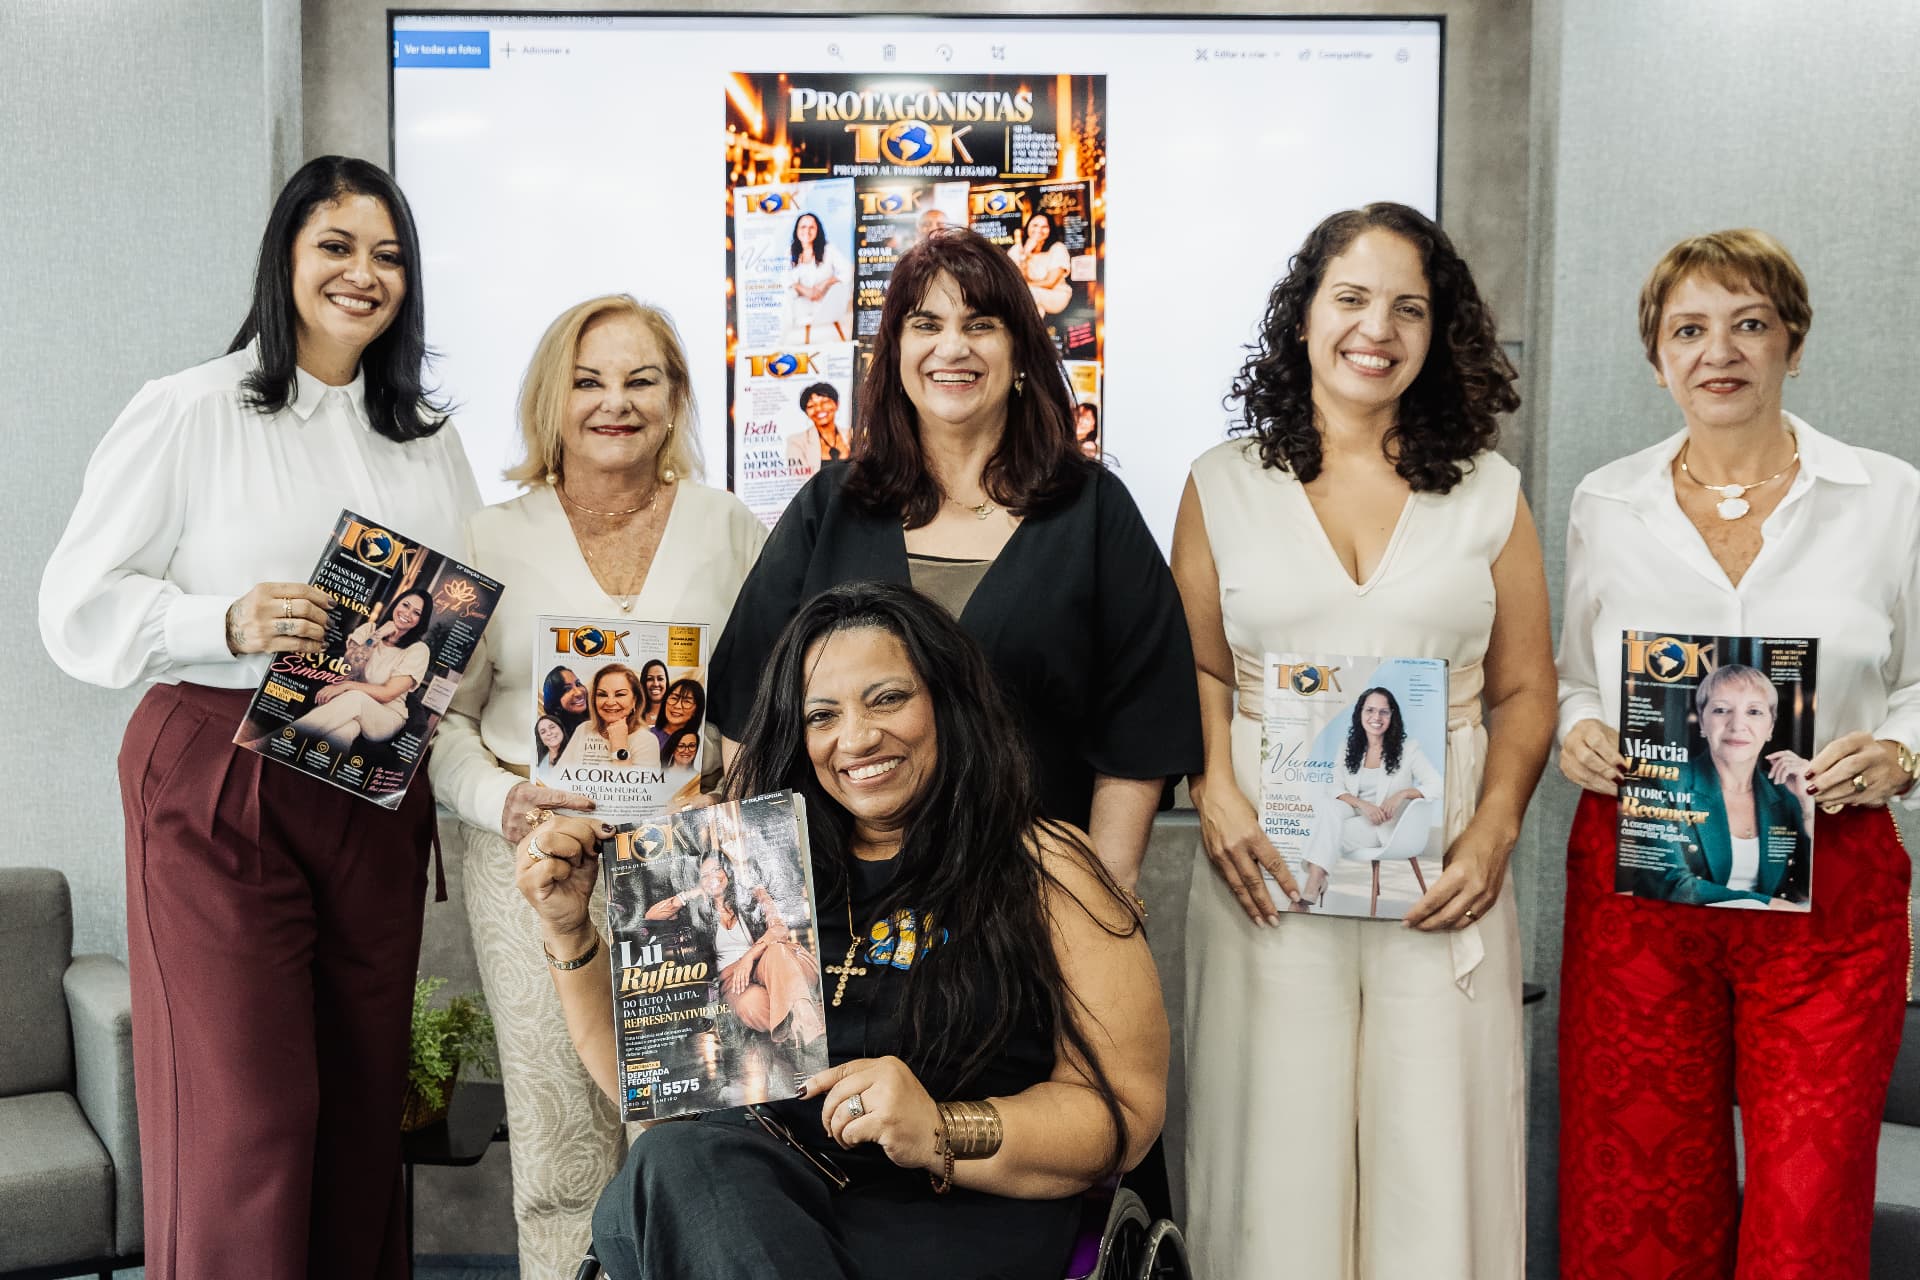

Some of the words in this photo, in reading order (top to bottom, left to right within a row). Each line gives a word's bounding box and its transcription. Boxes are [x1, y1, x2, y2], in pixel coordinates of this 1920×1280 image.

[404, 44, 420, 55] Ver
[422, 44, 446, 55] todas
[459, 44, 482, 55] fotos
[789, 88, 1034, 123] PROTAGONISTAS
[833, 164, 875, 177] PROJETO
[955, 164, 998, 177] LEGADO
[324, 577, 354, 597] FUTURO
[354, 591, 368, 603] EM
[327, 570, 366, 594] PRESENTE
[270, 655, 346, 685] Simone
[328, 656, 352, 676] de
[1624, 737, 1689, 763] Márcia
[560, 767, 572, 781] A
[575, 768, 666, 785] CORAGEM
[1284, 767, 1334, 783] Oliveira
[1624, 756, 1680, 781] Lima
[572, 784, 584, 792] DE
[585, 784, 612, 795] QUEM
[614, 786, 648, 795] NUNCA
[603, 793, 614, 801] DE
[618, 794, 653, 802] TENTAR
[1265, 802, 1314, 812] DEDICADA
[1265, 817, 1301, 826] OUTRAS
[1265, 826, 1310, 836] HISTÓRIAS
[619, 935, 664, 969] Lú
[619, 960, 708, 994] Rufino
[623, 999, 637, 1009] DO
[639, 995, 664, 1008] LUTO
[623, 1009, 637, 1018] DA
[638, 1005, 662, 1017] LUTA
[627, 1067, 670, 1080] DEPUTADA
[627, 1075, 661, 1086] FEDERAL
[628, 1084, 651, 1101] psd
[662, 1077, 700, 1096] 5575
